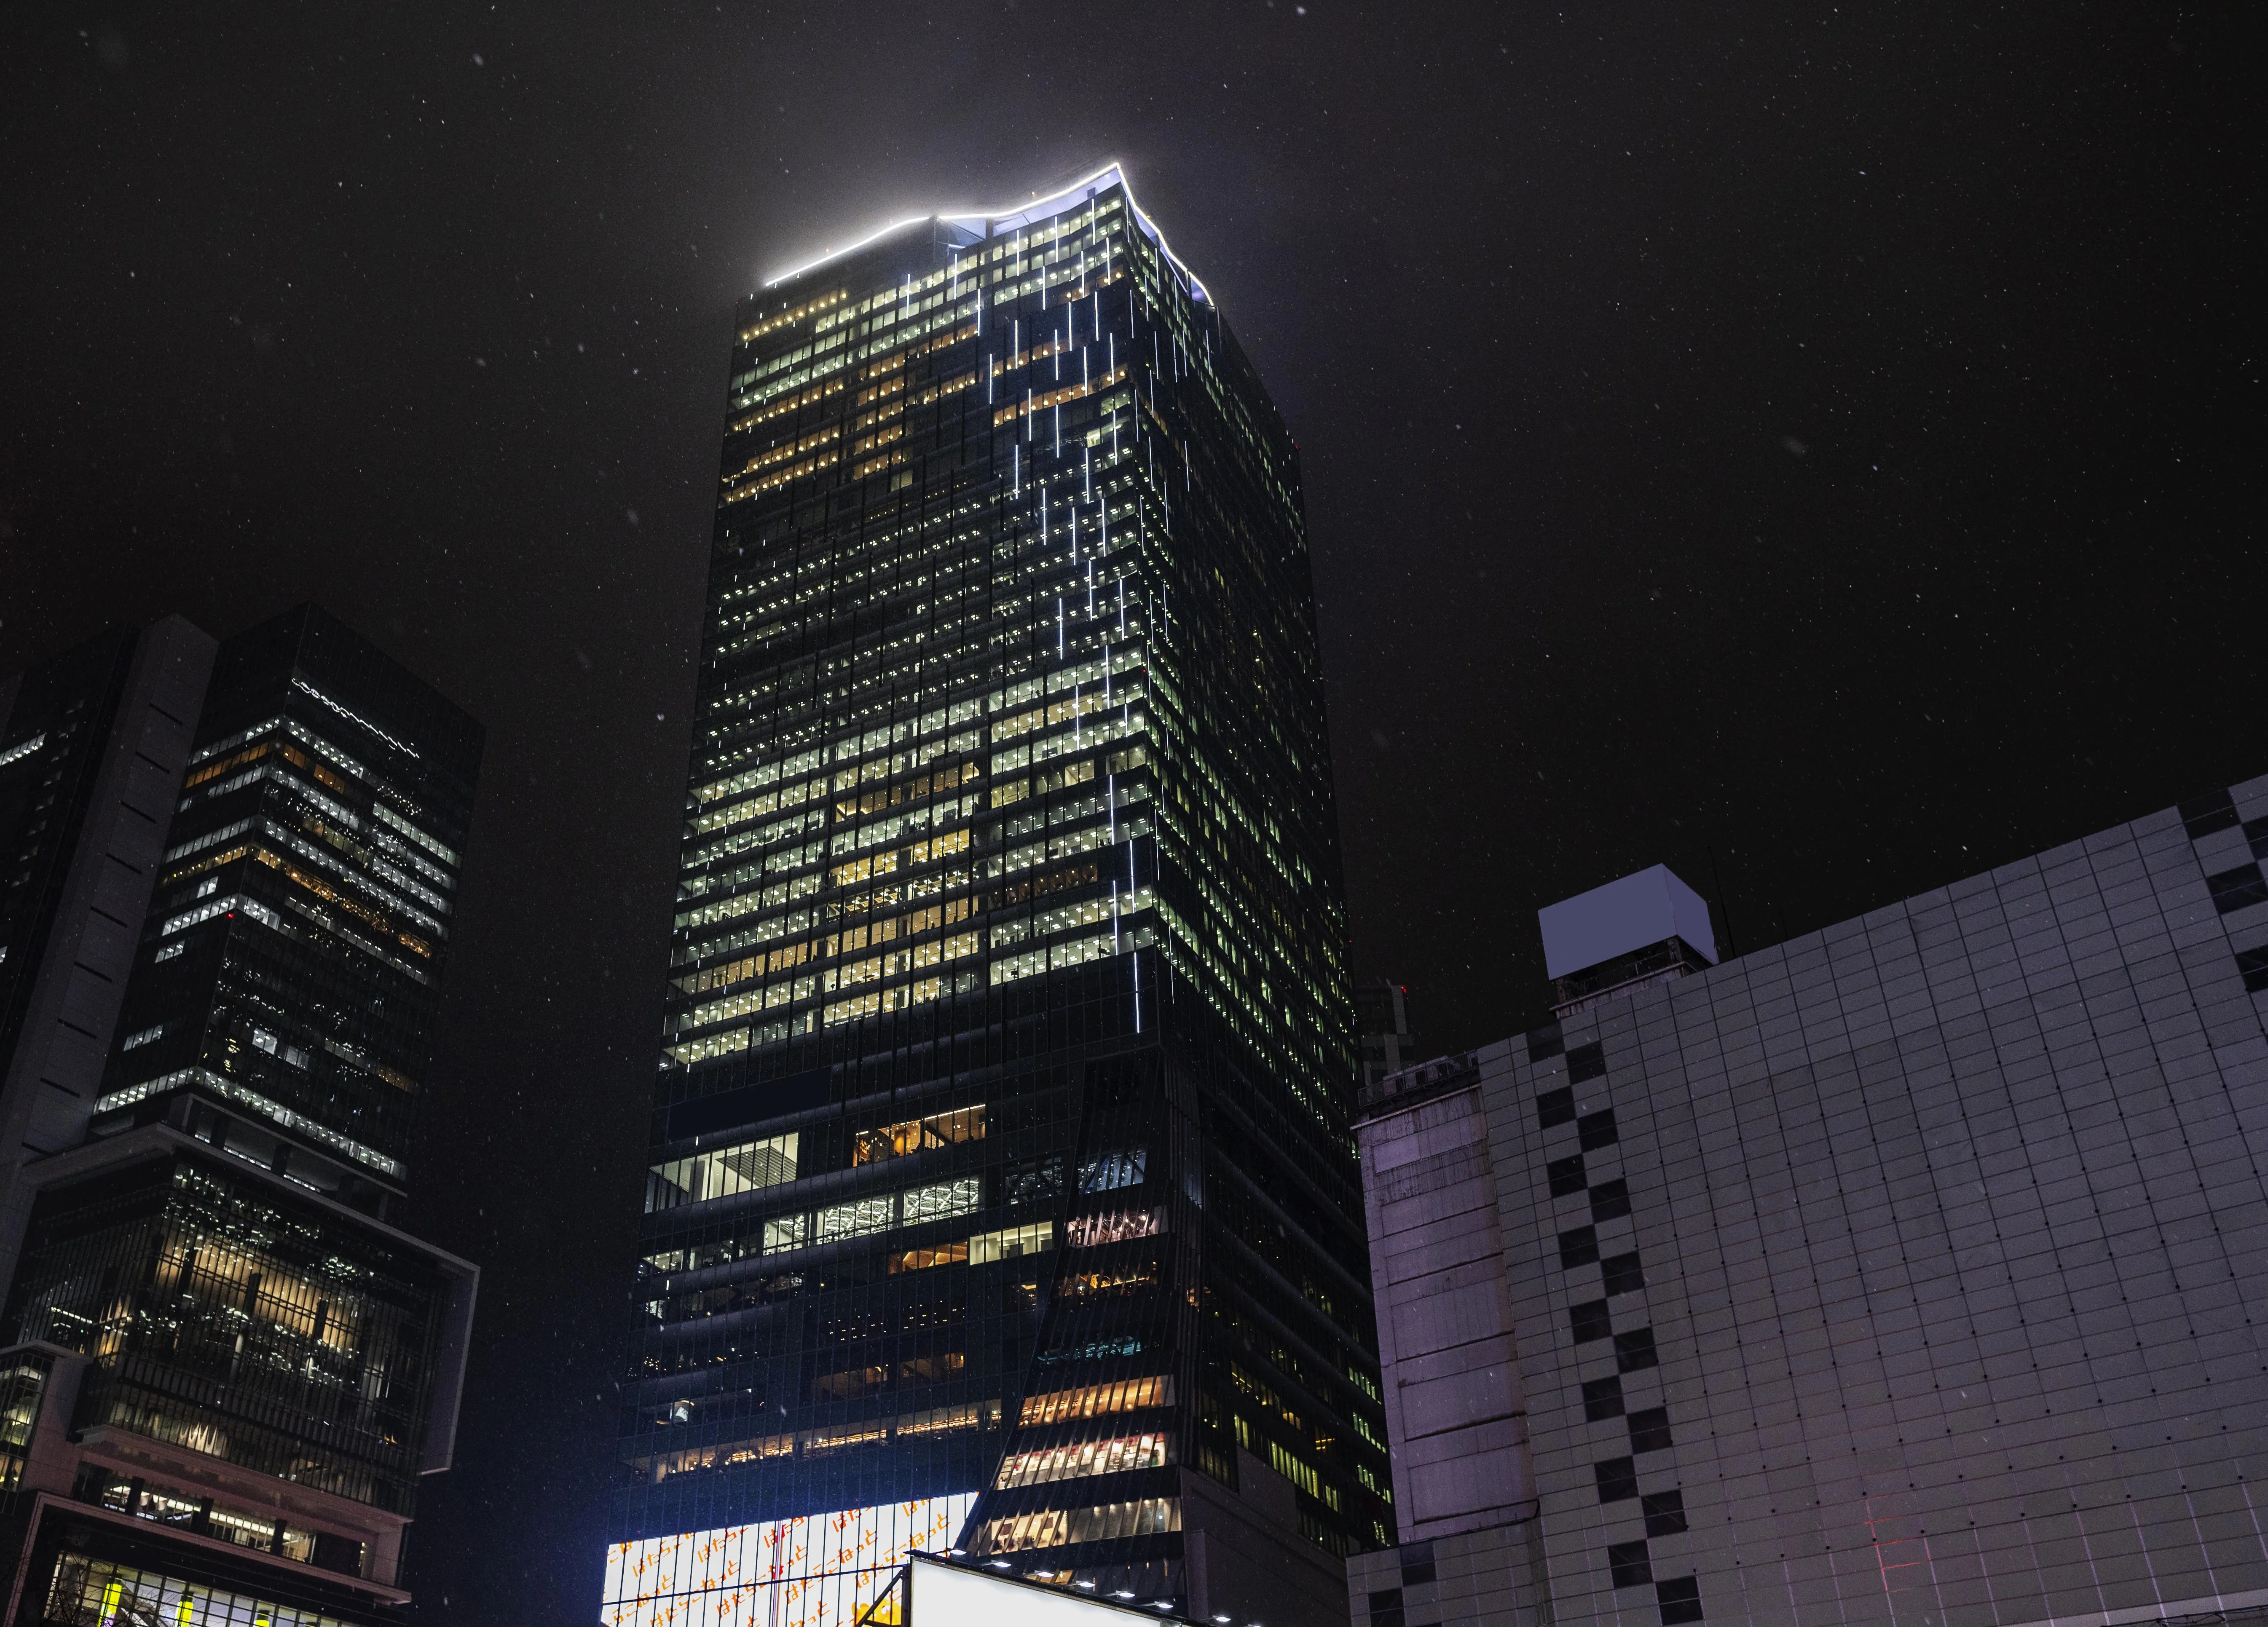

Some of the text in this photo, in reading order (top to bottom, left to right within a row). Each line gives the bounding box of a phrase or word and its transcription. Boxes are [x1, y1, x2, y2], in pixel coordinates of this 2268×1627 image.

[785, 1529, 878, 1604] はたらこねっと
[855, 1513, 951, 1589] はたらこねっと
[604, 1575, 674, 1625] らこねっと
